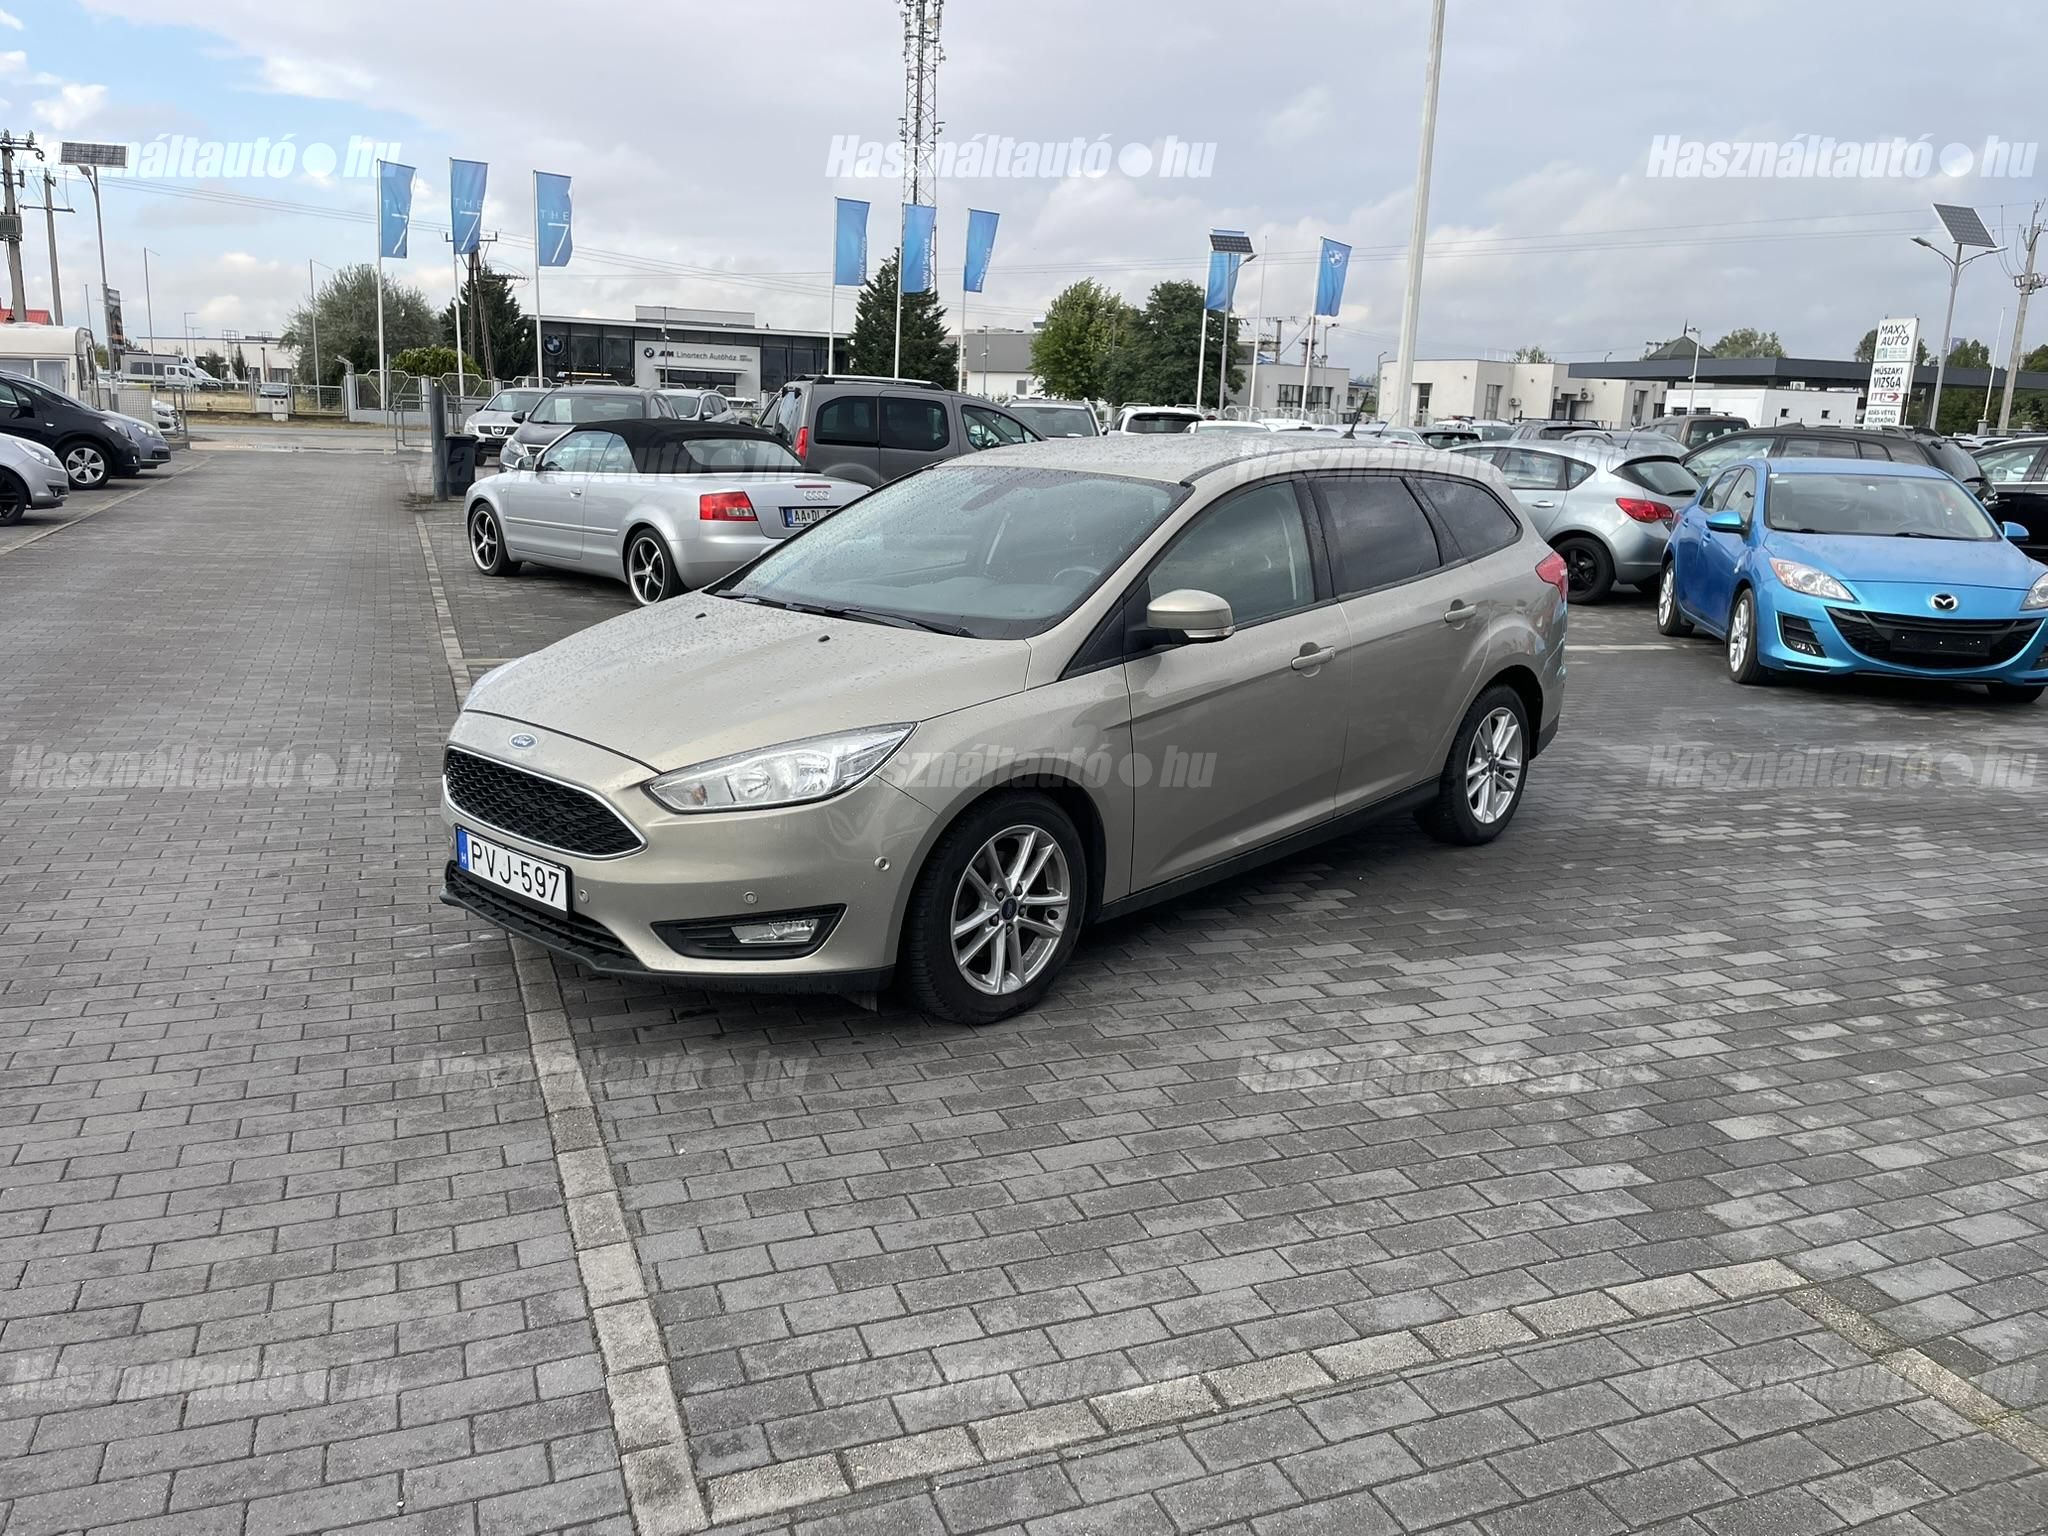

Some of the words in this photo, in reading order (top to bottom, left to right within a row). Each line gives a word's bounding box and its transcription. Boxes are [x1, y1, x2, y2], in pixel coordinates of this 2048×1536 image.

[453, 198, 483, 208] THE
[540, 209, 569, 221] THE
[460, 210, 480, 251] 7
[547, 222, 570, 263] 7
[1880, 324, 1907, 335] MAXX
[1873, 377, 1901, 388] VIZSGA
[795, 510, 807, 522] AA
[470, 840, 560, 902] PVJ-597
